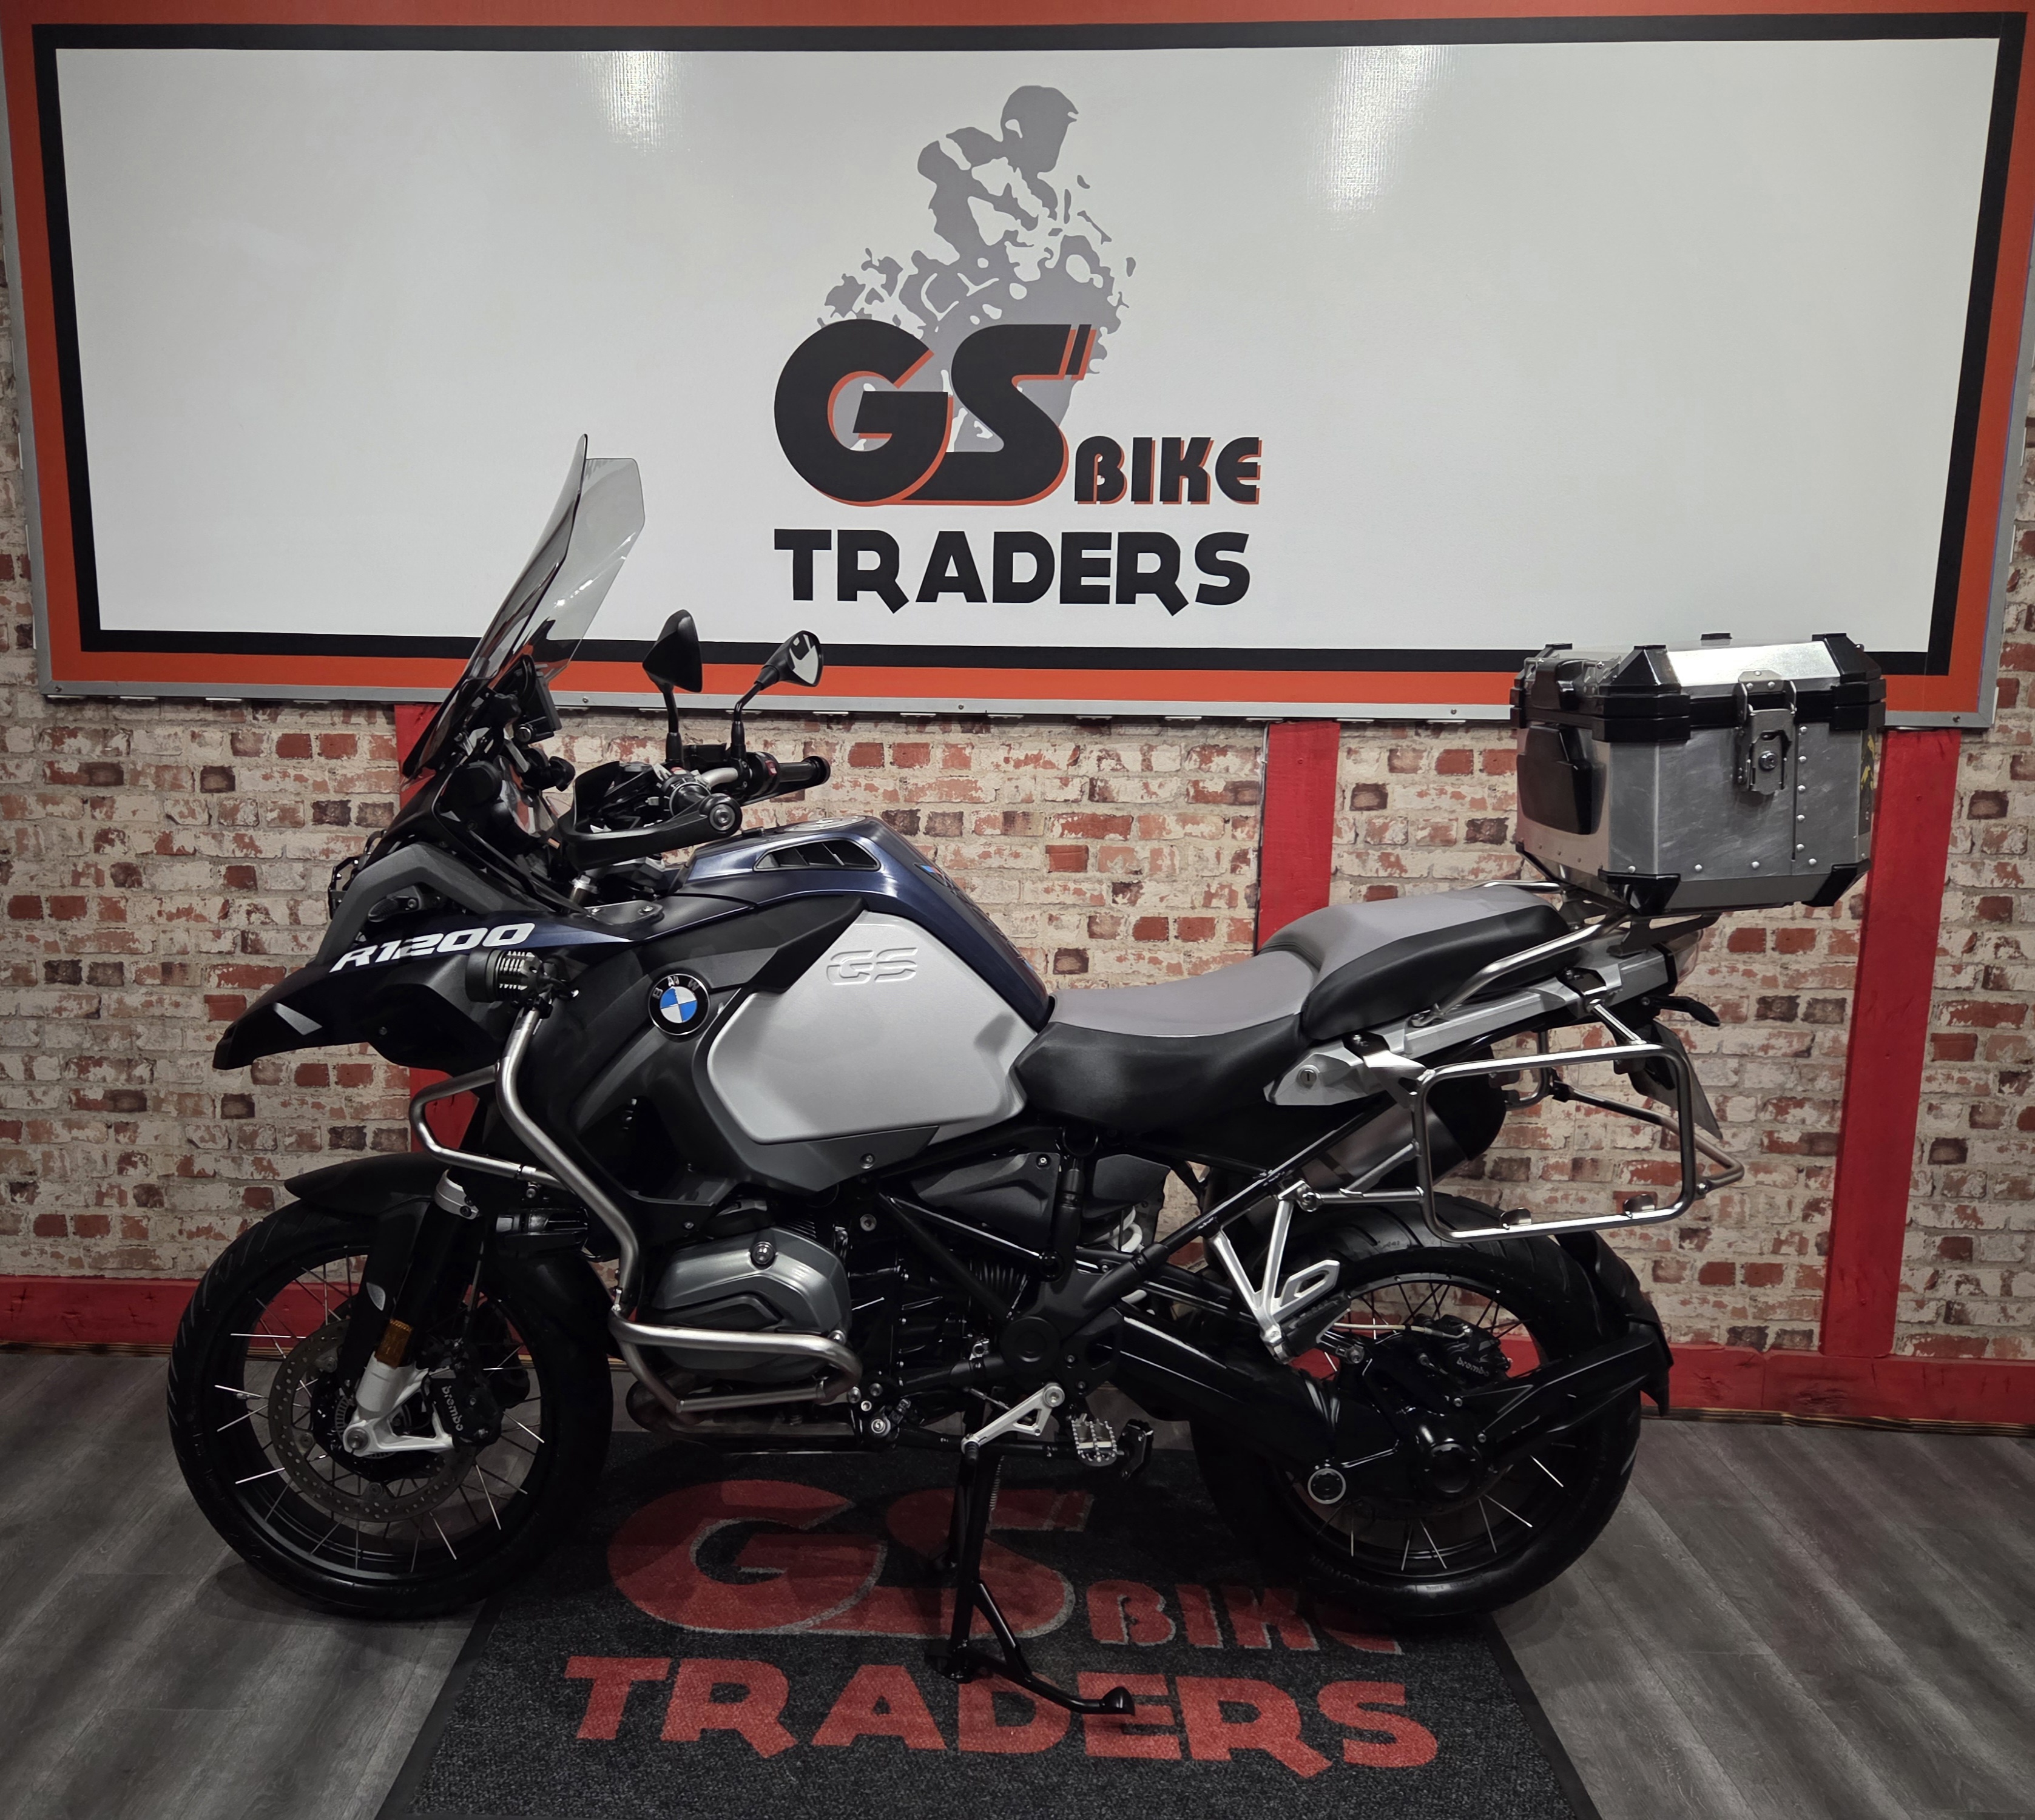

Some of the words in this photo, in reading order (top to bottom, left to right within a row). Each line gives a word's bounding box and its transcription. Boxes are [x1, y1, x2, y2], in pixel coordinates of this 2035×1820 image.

[774, 319, 1097, 507] GS
[1075, 436, 1262, 505] BIKE
[774, 528, 1250, 616] TRADERS
[329, 923, 535, 972] R1200
[826, 947, 918, 985] GS
[652, 976, 700, 1000] BMW
[441, 1385, 464, 1432] brembo
[608, 1479, 1093, 1640] GS
[564, 1656, 1437, 1779] TRADERS
